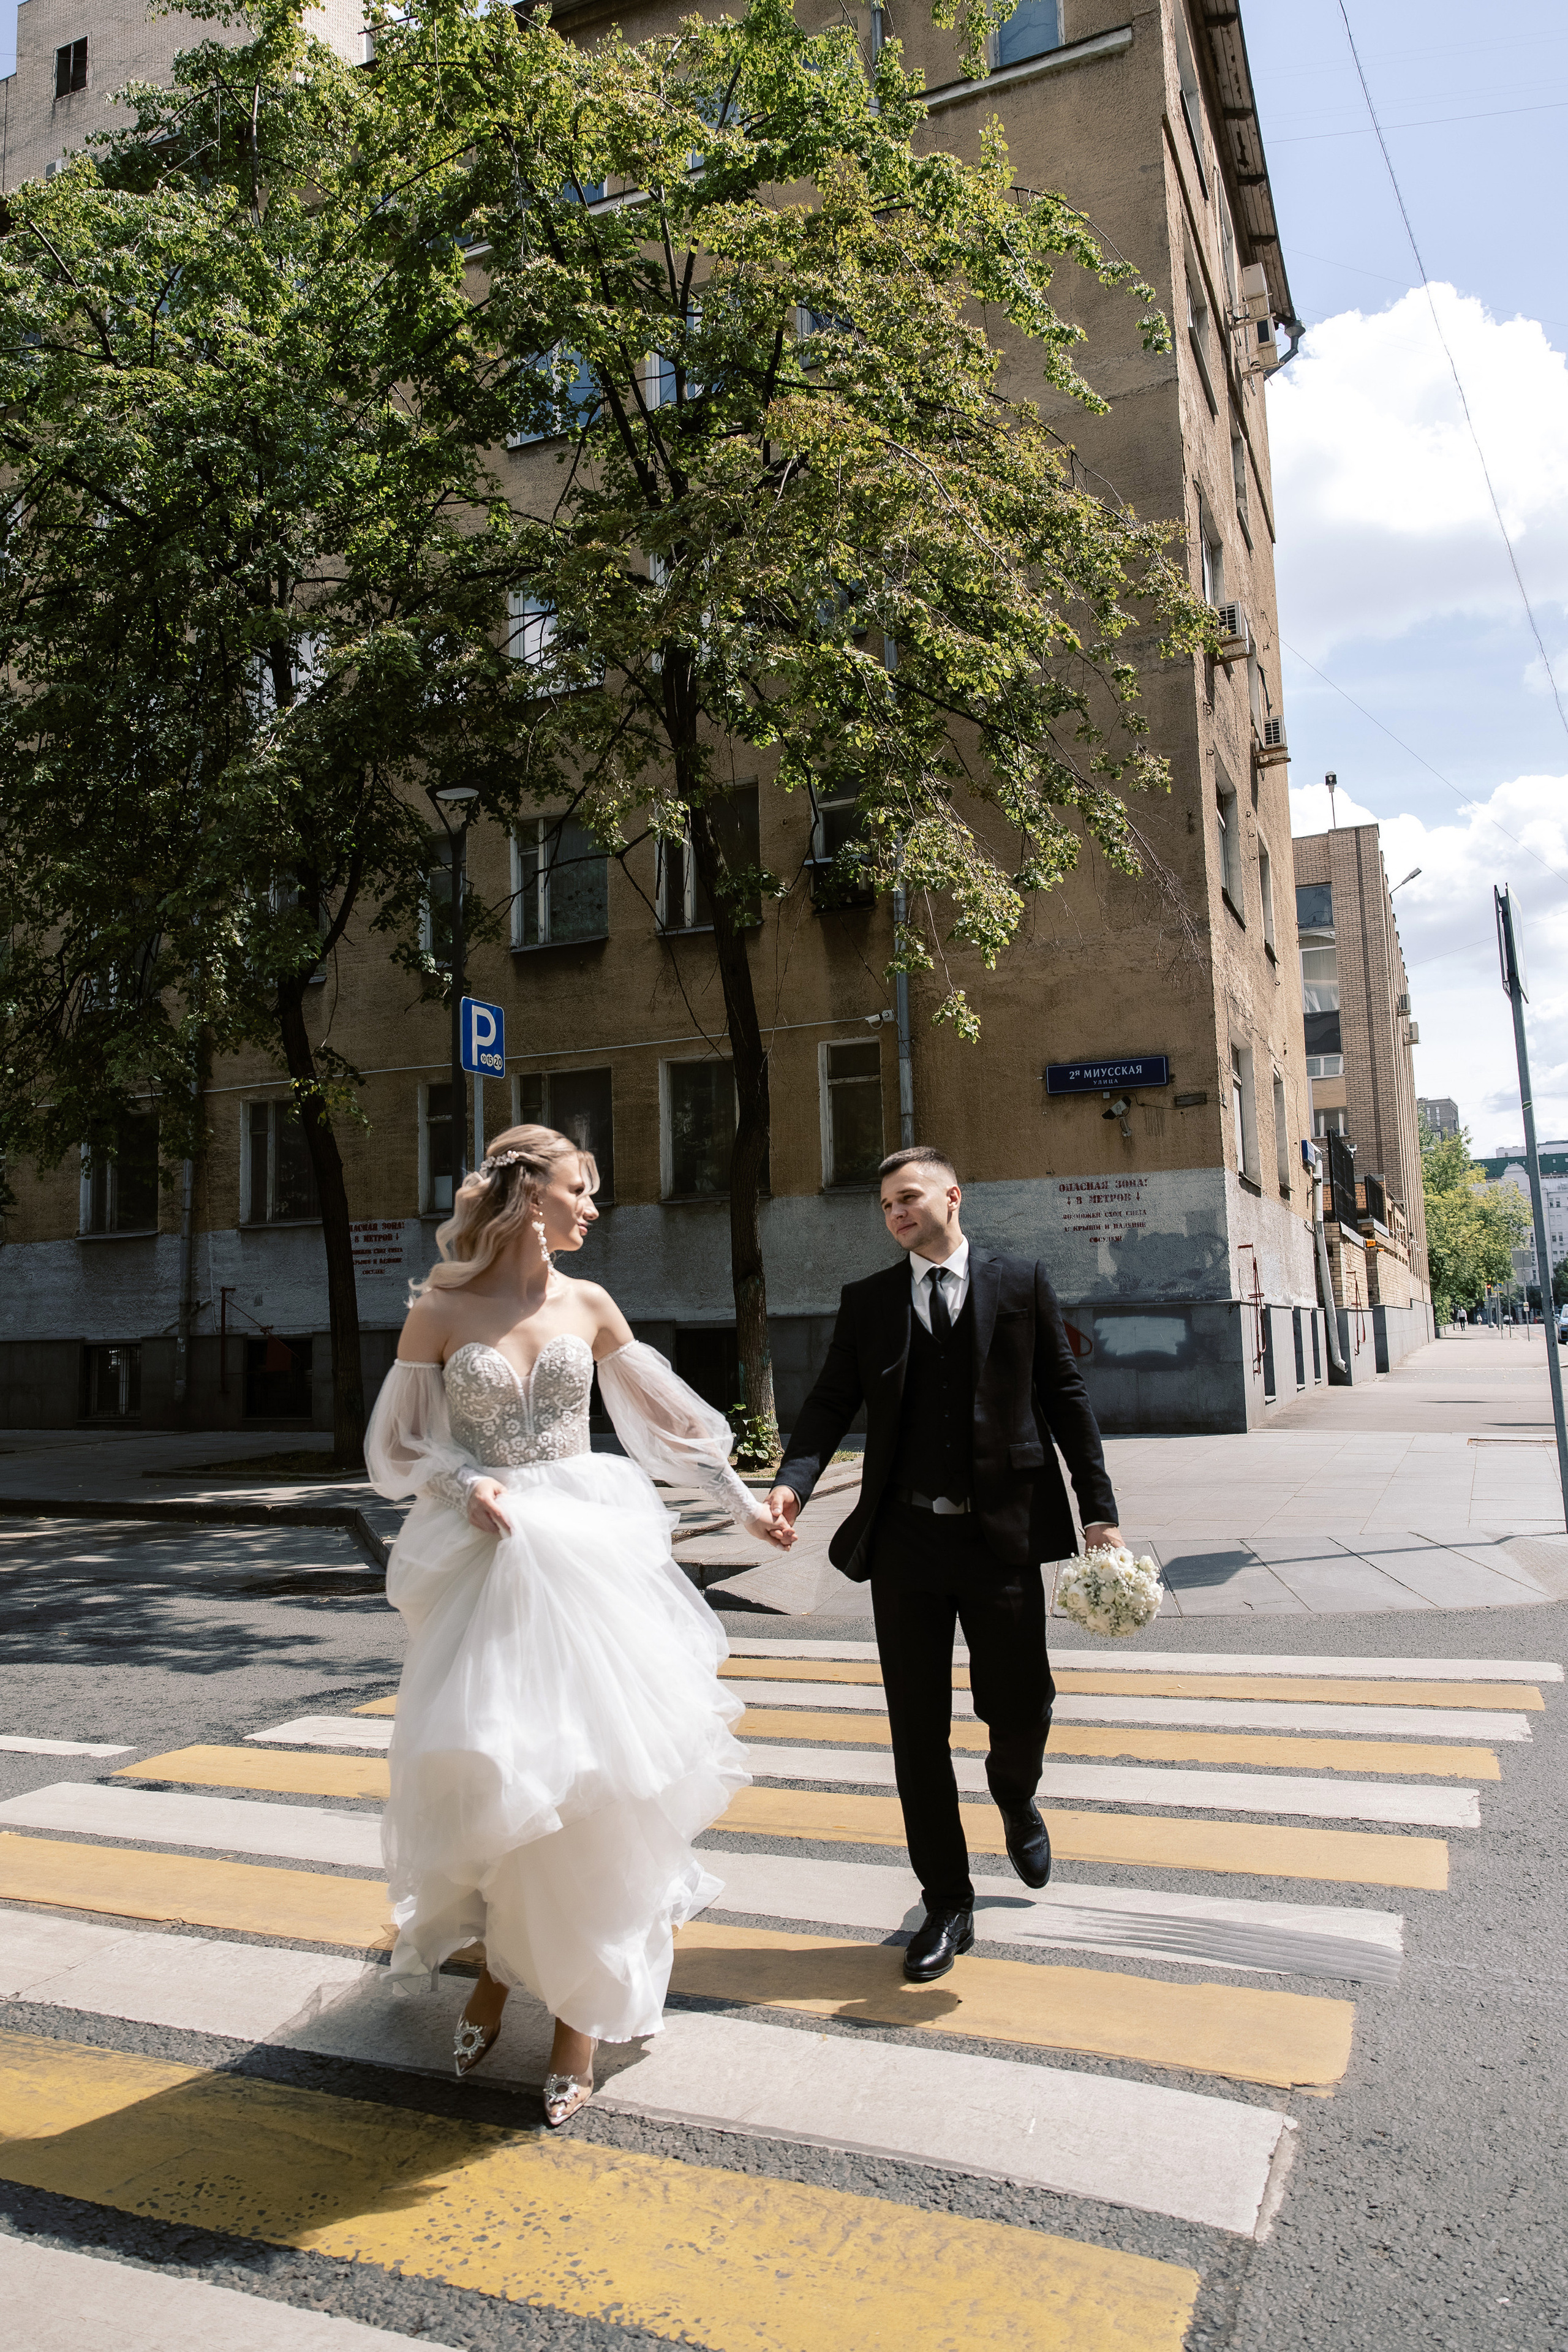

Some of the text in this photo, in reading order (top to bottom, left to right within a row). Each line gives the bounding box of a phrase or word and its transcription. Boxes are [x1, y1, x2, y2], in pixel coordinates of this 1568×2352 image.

[472, 1005, 496, 1066] P
[488, 1056, 492, 1065] 15
[494, 1057, 502, 1068] 20
[1084, 1065, 1142, 1078] МИУССКАЯ
[1058, 1178, 1148, 1193] ОПАСНАЯ ЗОНА!
[1089, 1193, 1131, 1204] МЕТРОВ
[382, 1221, 405, 1230] ЗОНА!
[363, 1234, 393, 1242] МЕТРОВ
